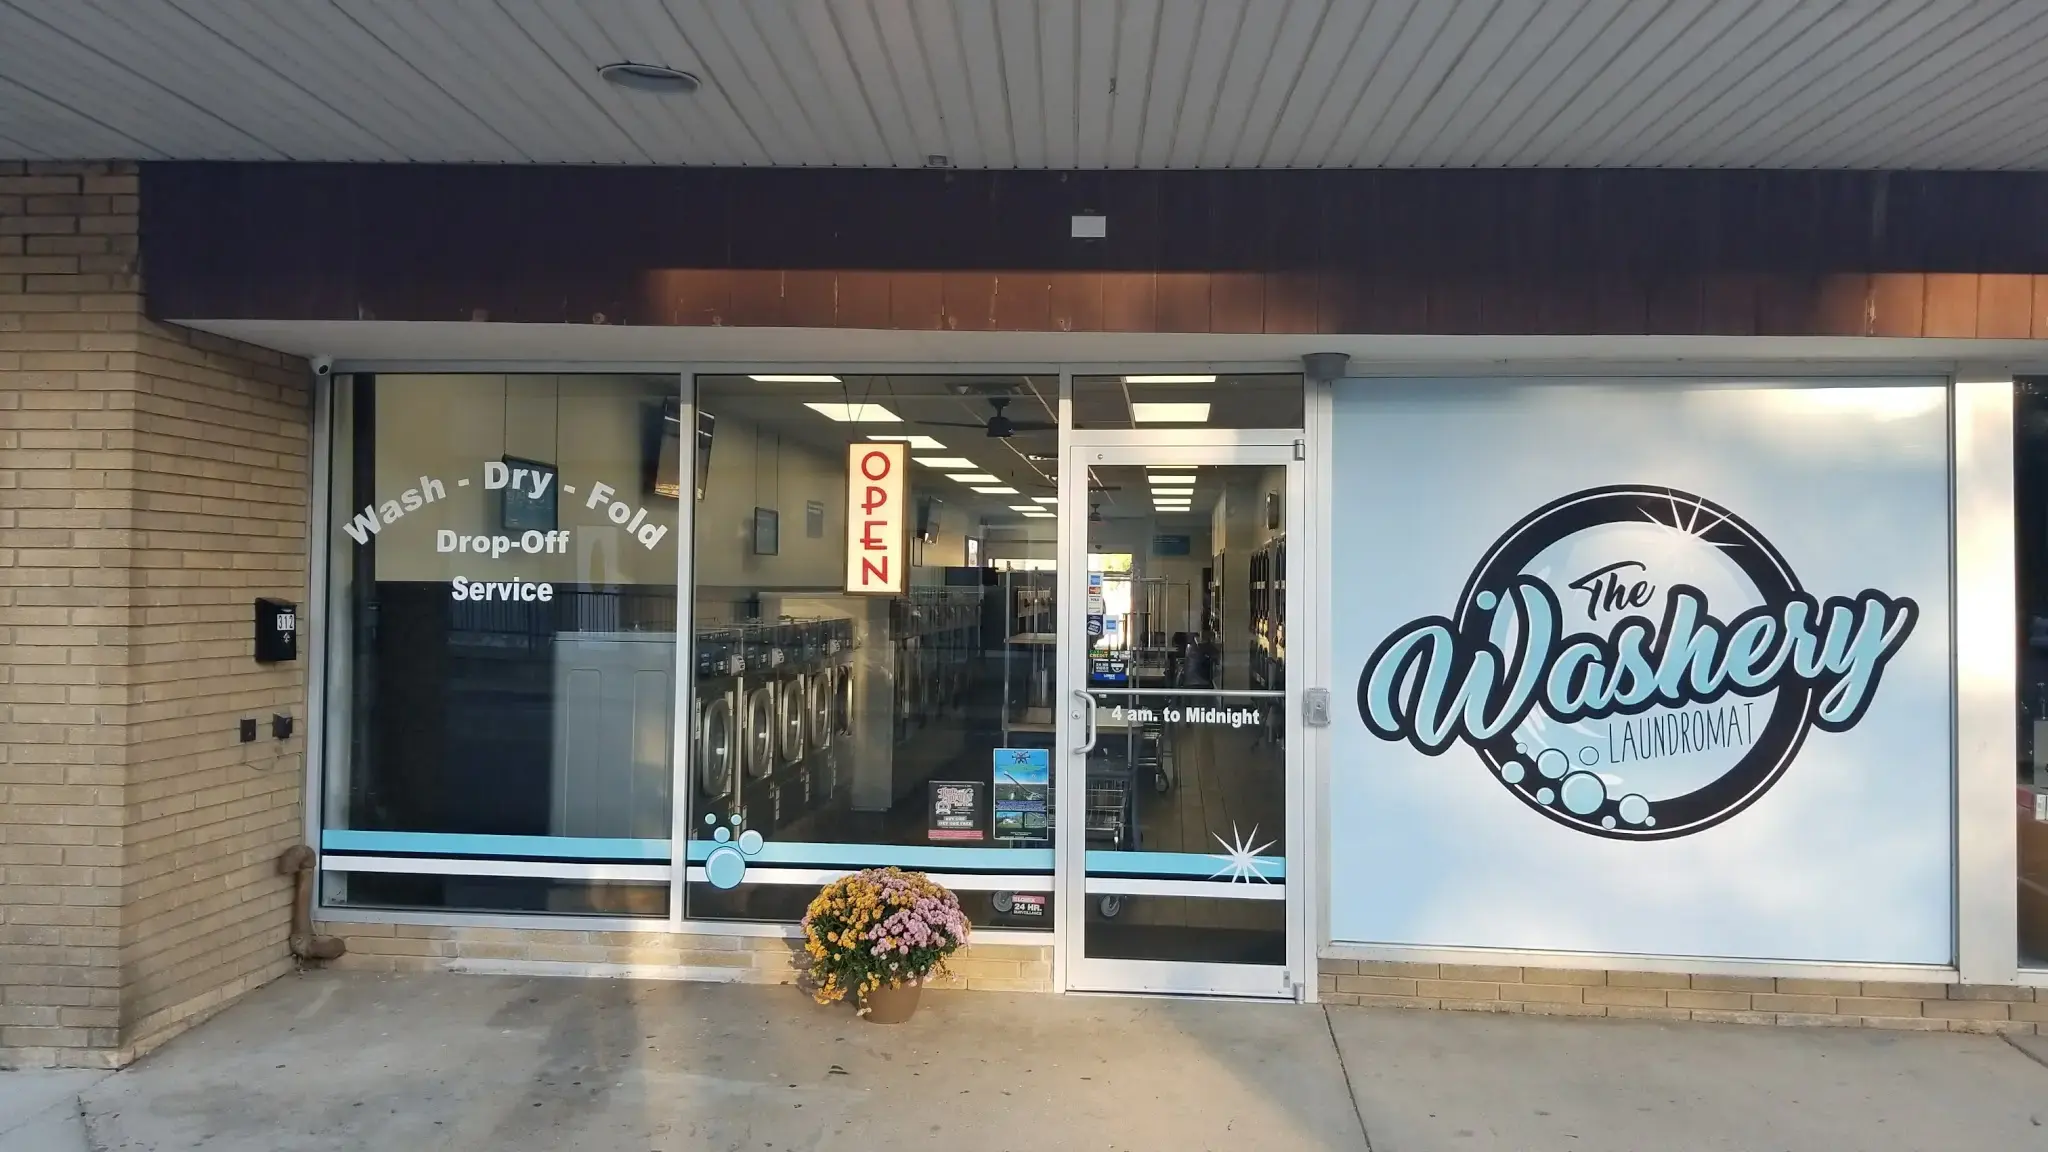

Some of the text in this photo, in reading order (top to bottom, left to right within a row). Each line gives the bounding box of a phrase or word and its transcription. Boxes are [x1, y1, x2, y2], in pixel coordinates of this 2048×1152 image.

[343, 475, 447, 546] Wash
[484, 461, 553, 500] Dry
[585, 480, 669, 550] Fold
[860, 451, 891, 585] OPEN
[436, 529, 571, 559] Drop-Off
[451, 575, 554, 602] Service
[1568, 560, 1656, 622] The
[278, 615, 294, 629] 312
[1357, 574, 1920, 757] Washery
[1111, 704, 1260, 728] 4 am. to Midnight
[1608, 703, 1757, 765] LAUNDROMAT
[1027, 903, 1043, 911] HR.
